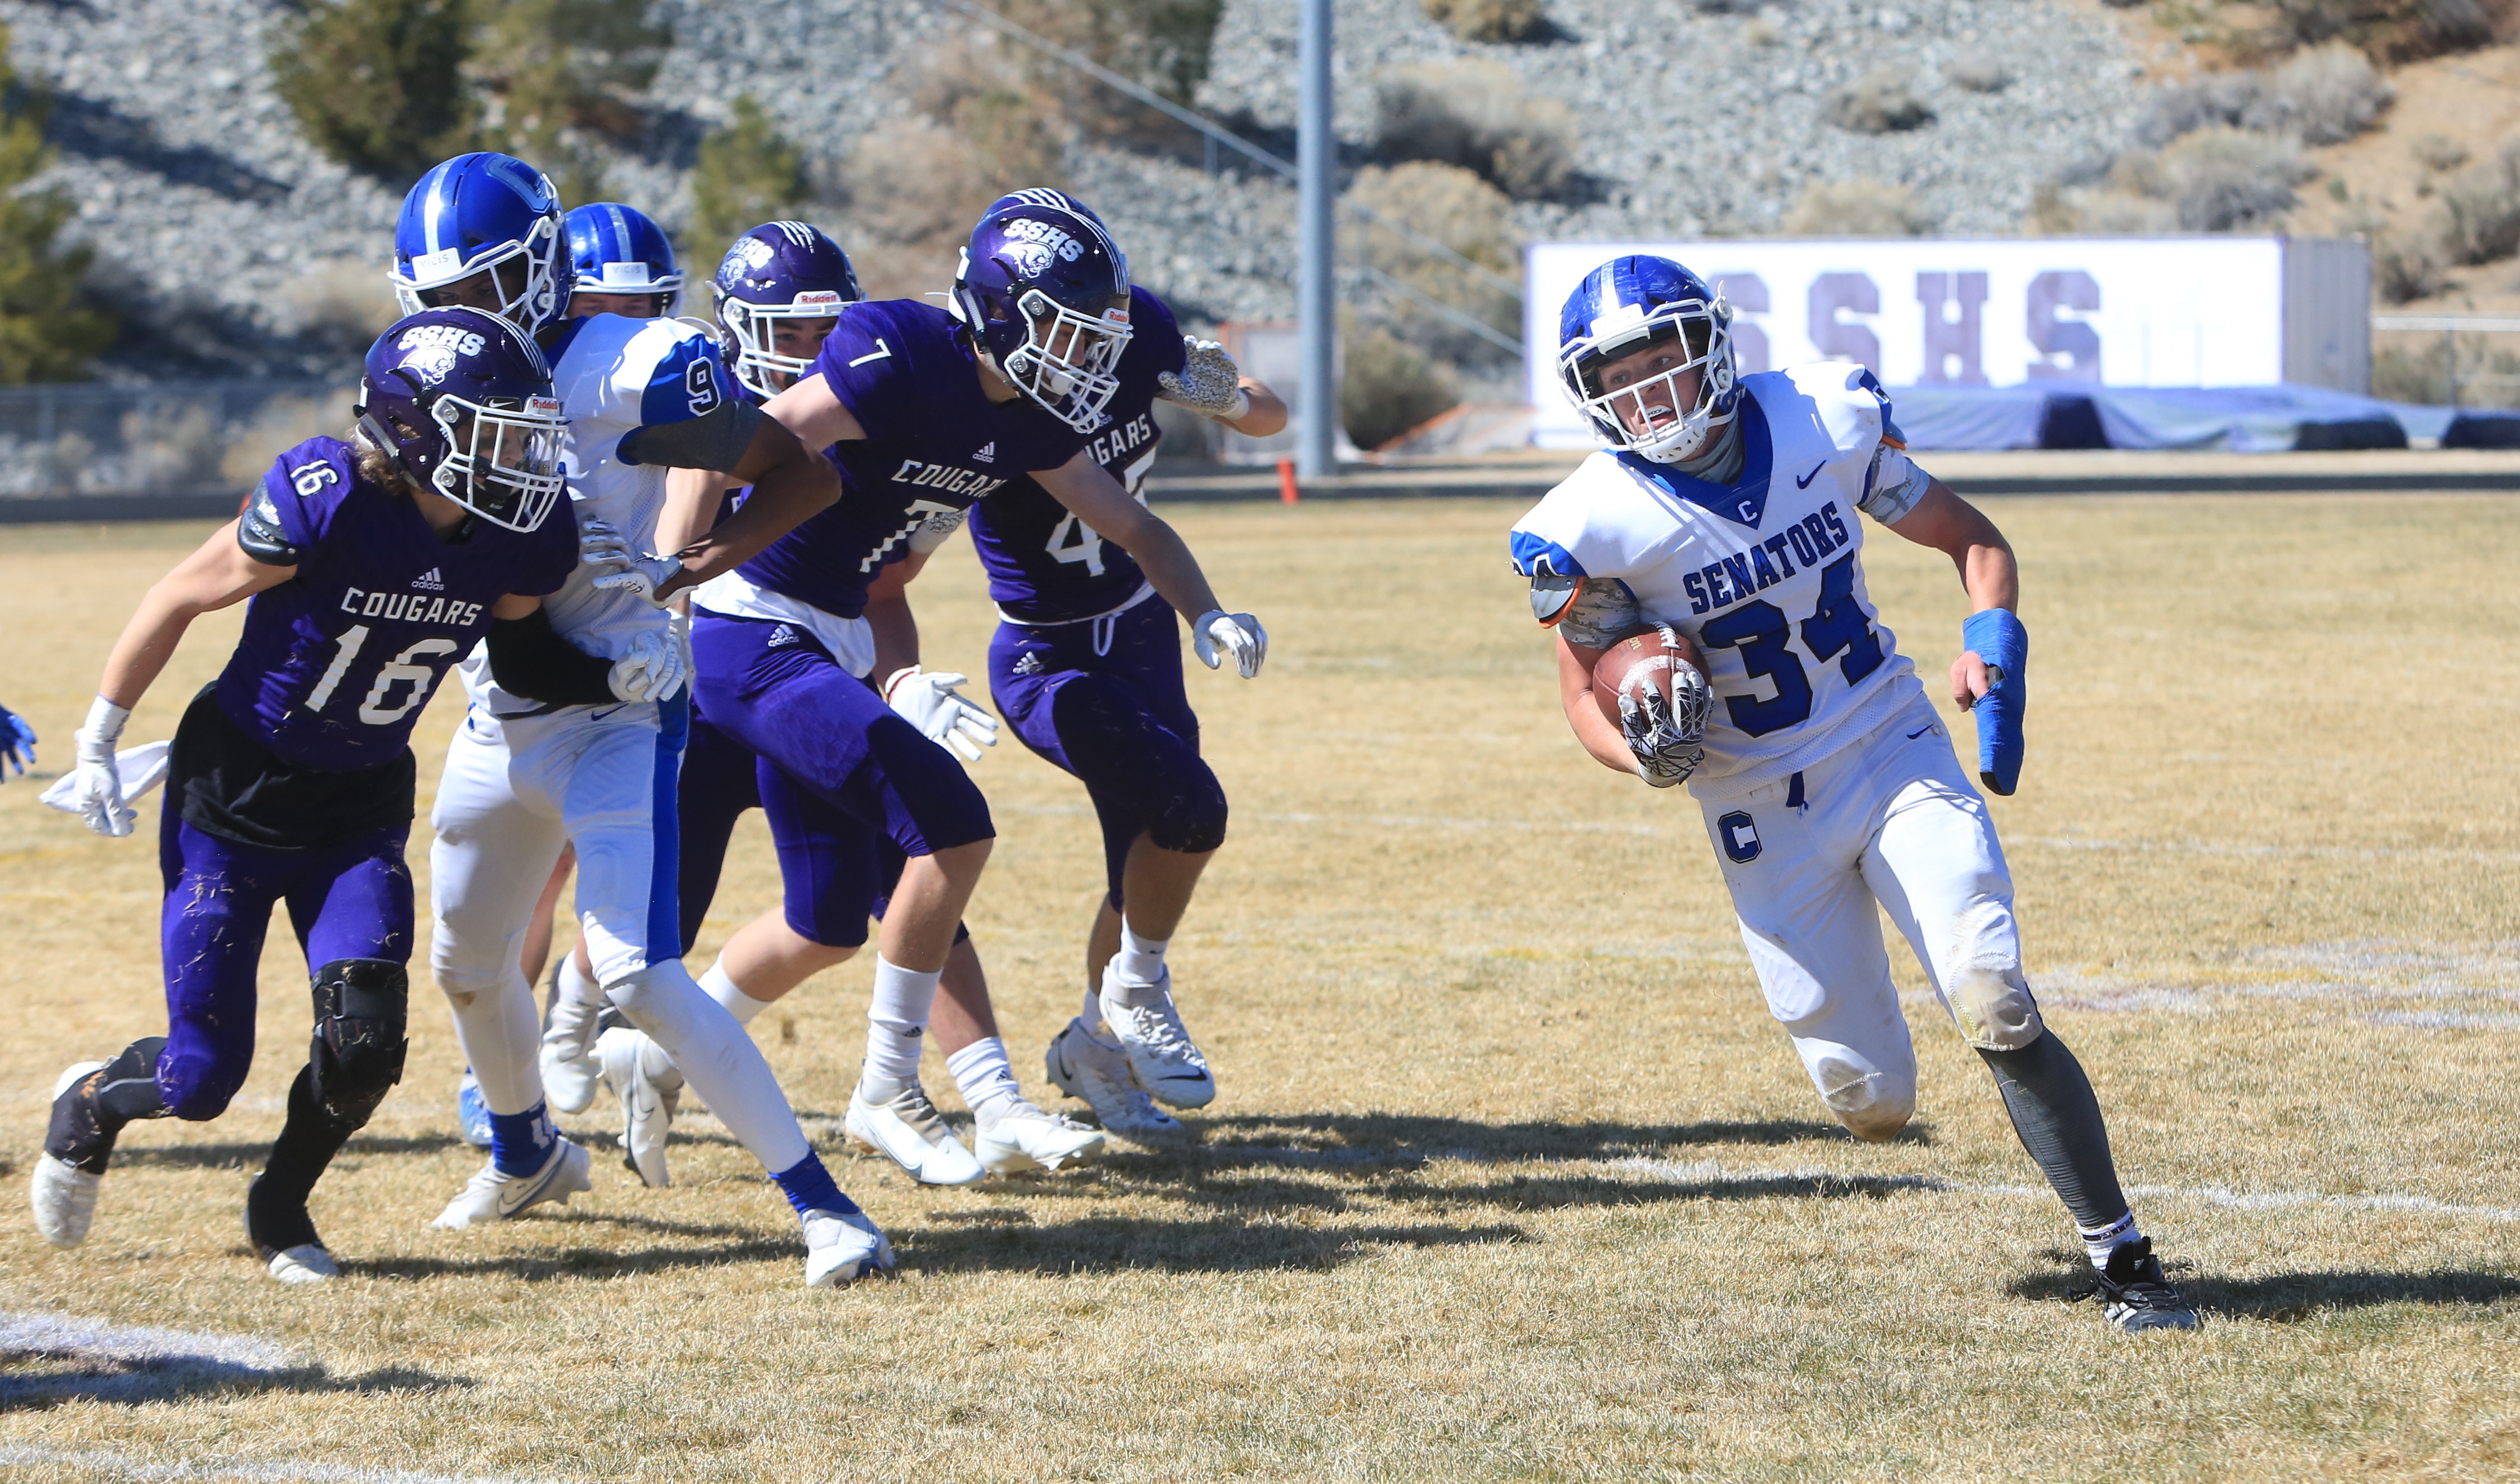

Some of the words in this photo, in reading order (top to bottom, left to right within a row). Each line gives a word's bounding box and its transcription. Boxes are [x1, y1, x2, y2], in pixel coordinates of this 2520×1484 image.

[1004, 218, 1085, 261] SSHS
[420, 254, 449, 267] VICIS
[801, 294, 836, 303] Riddell
[398, 325, 486, 357] SSHS
[849, 337, 892, 368] 7
[686, 356, 721, 417] 9
[290, 459, 338, 497] 16
[891, 459, 1007, 498] COUGAR
[1738, 500, 1758, 522] C
[859, 499, 959, 573] 7
[1683, 501, 1849, 615] SENATORS
[411, 579, 444, 591] adidas
[340, 587, 483, 626] COUGARS
[1698, 548, 1886, 739] 34
[305, 624, 458, 725] 16
[1717, 810, 1763, 864] C
